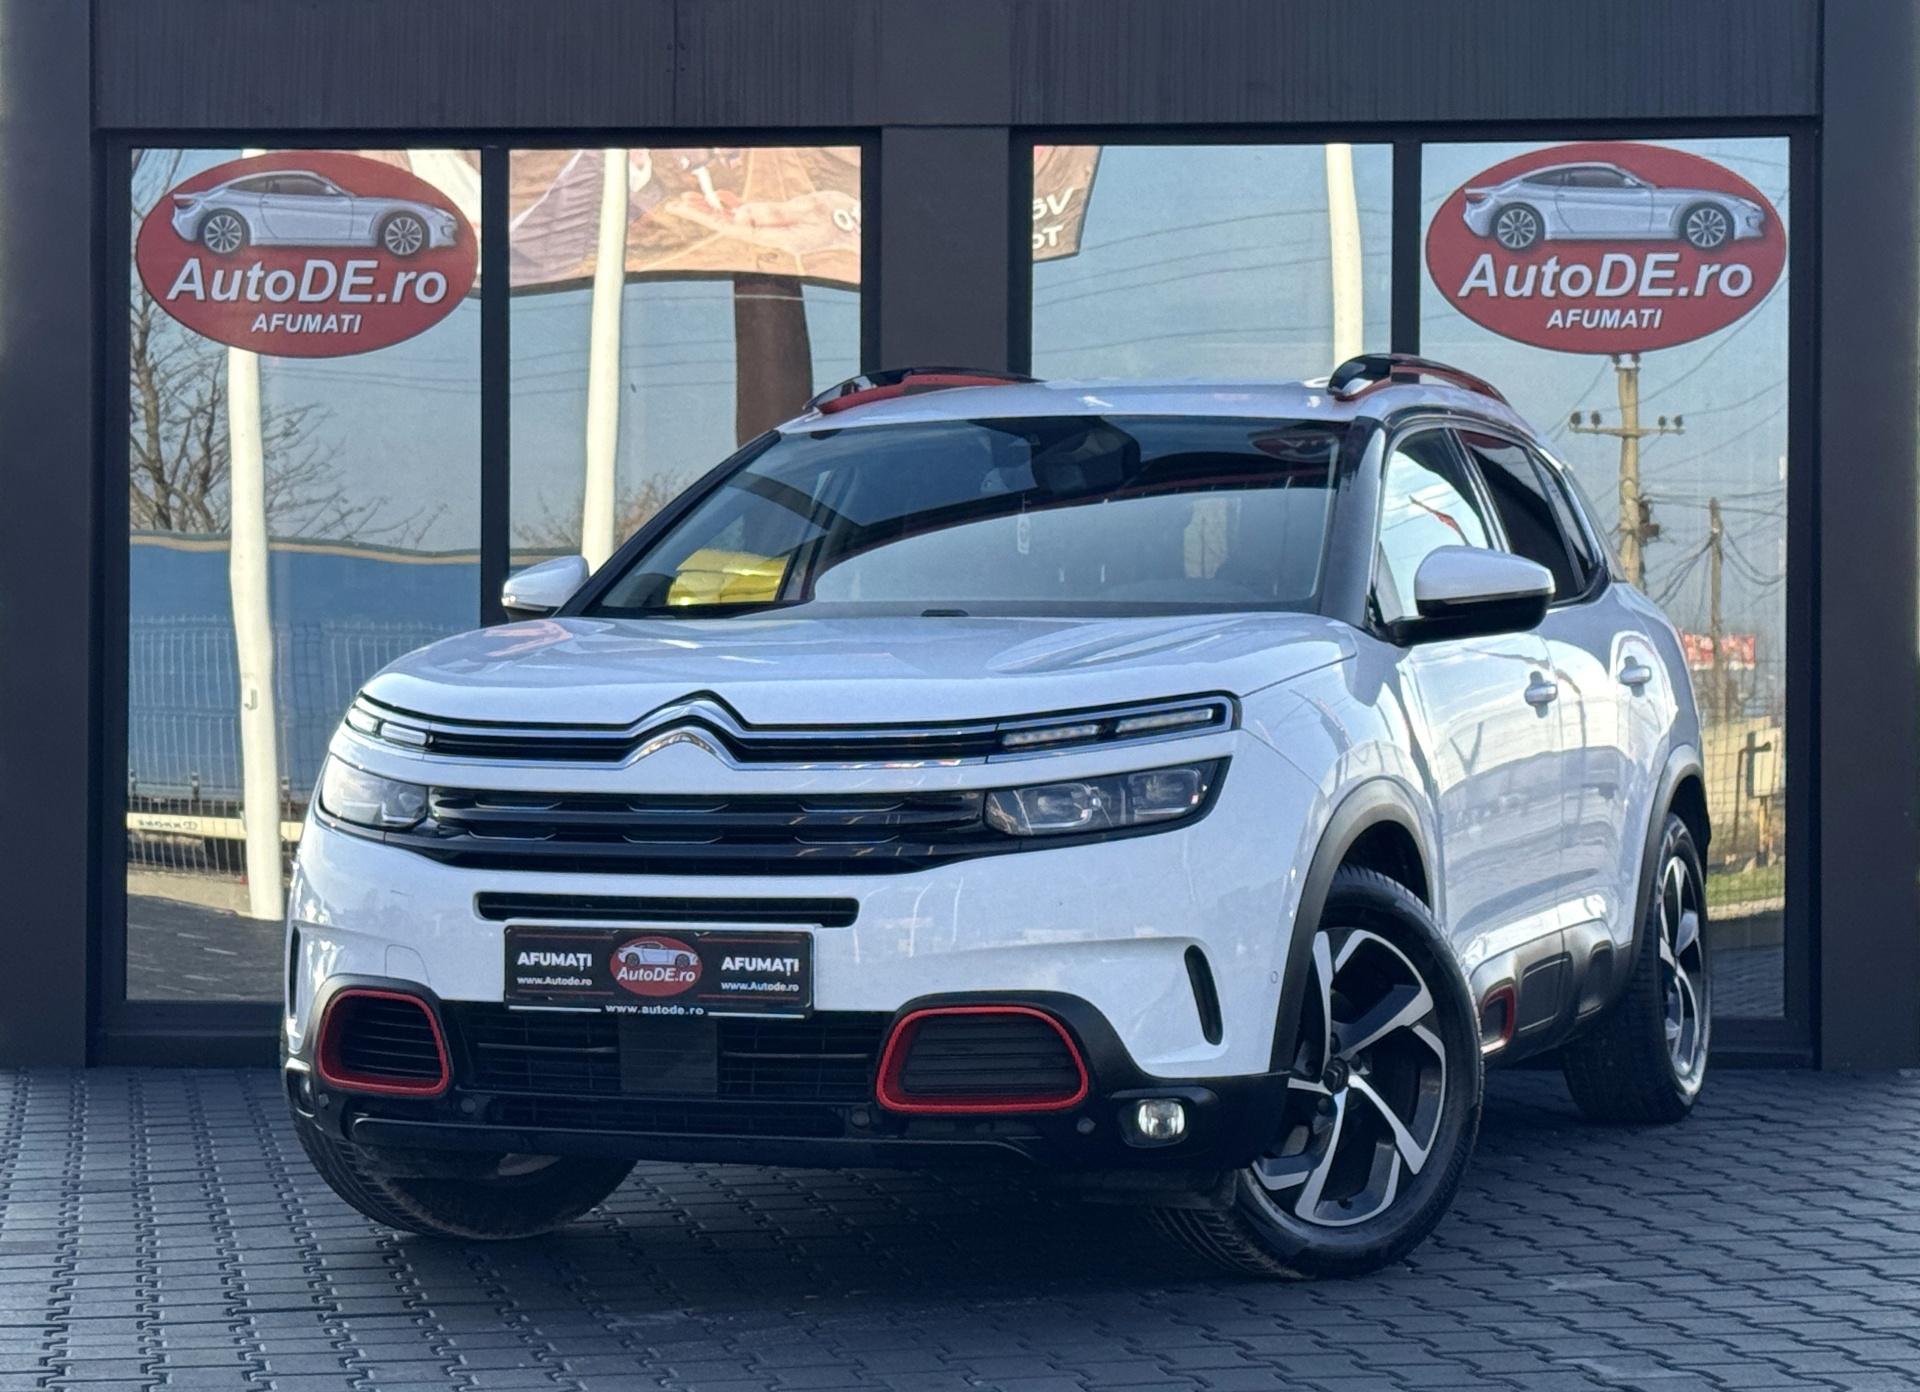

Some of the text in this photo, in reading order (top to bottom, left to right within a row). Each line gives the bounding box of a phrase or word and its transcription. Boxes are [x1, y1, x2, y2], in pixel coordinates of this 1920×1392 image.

[166, 257, 448, 303] AutoDE.ro
[1457, 252, 1753, 298] AutoDE.ro
[251, 313, 363, 333] AFUMATI
[1546, 308, 1663, 329] AFUMATI
[516, 976, 593, 986] www.Autode.ro
[616, 966, 696, 982] AutoDE.ro
[720, 981, 800, 992] www.Autode.ro
[605, 1003, 704, 1016] www.autode.ro
